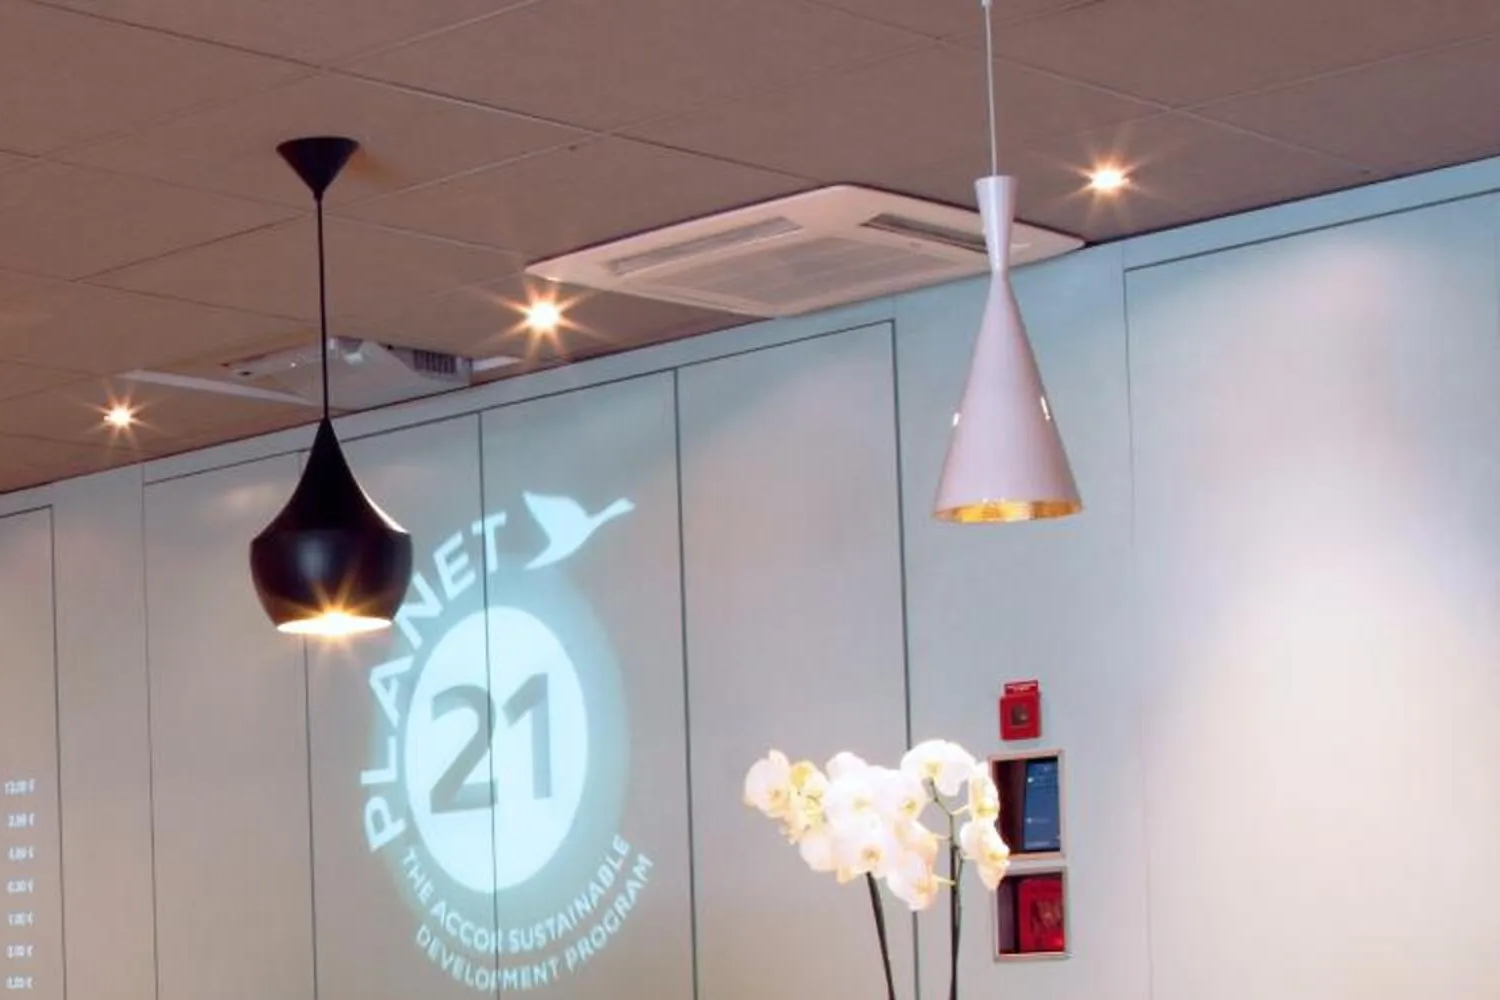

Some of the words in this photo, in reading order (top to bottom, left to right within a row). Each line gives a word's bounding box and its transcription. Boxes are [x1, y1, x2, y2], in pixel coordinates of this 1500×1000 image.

[360, 512, 507, 852] PLANET
[429, 671, 553, 816] 21
[400, 847, 432, 905] THE
[430, 900, 502, 955] ACCOR
[508, 833, 630, 952] SUSTAINABLE
[416, 924, 560, 992] DEVELOPMENT
[565, 854, 654, 973] PROGRAM
